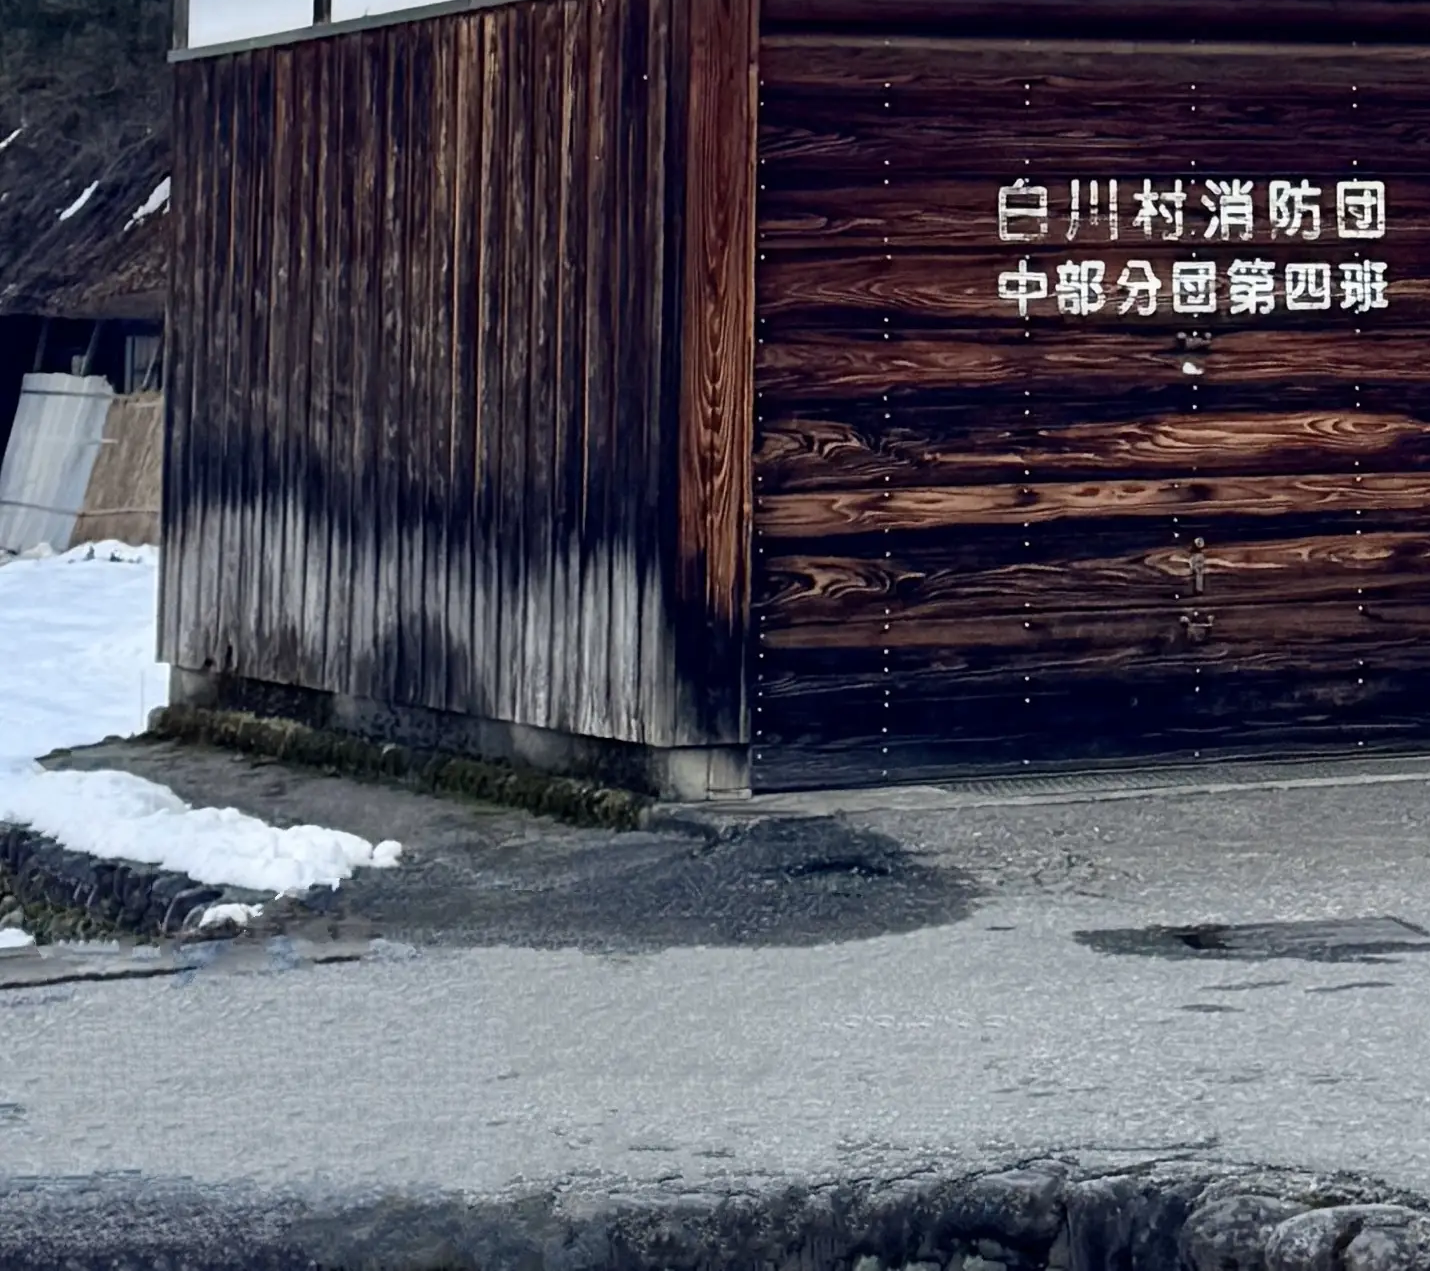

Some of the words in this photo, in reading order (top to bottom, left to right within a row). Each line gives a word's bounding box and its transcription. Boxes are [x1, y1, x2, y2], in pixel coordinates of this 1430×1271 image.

[998, 178, 1386, 241] 白川村消防団
[998, 258, 1389, 317] 中部分団第四班
